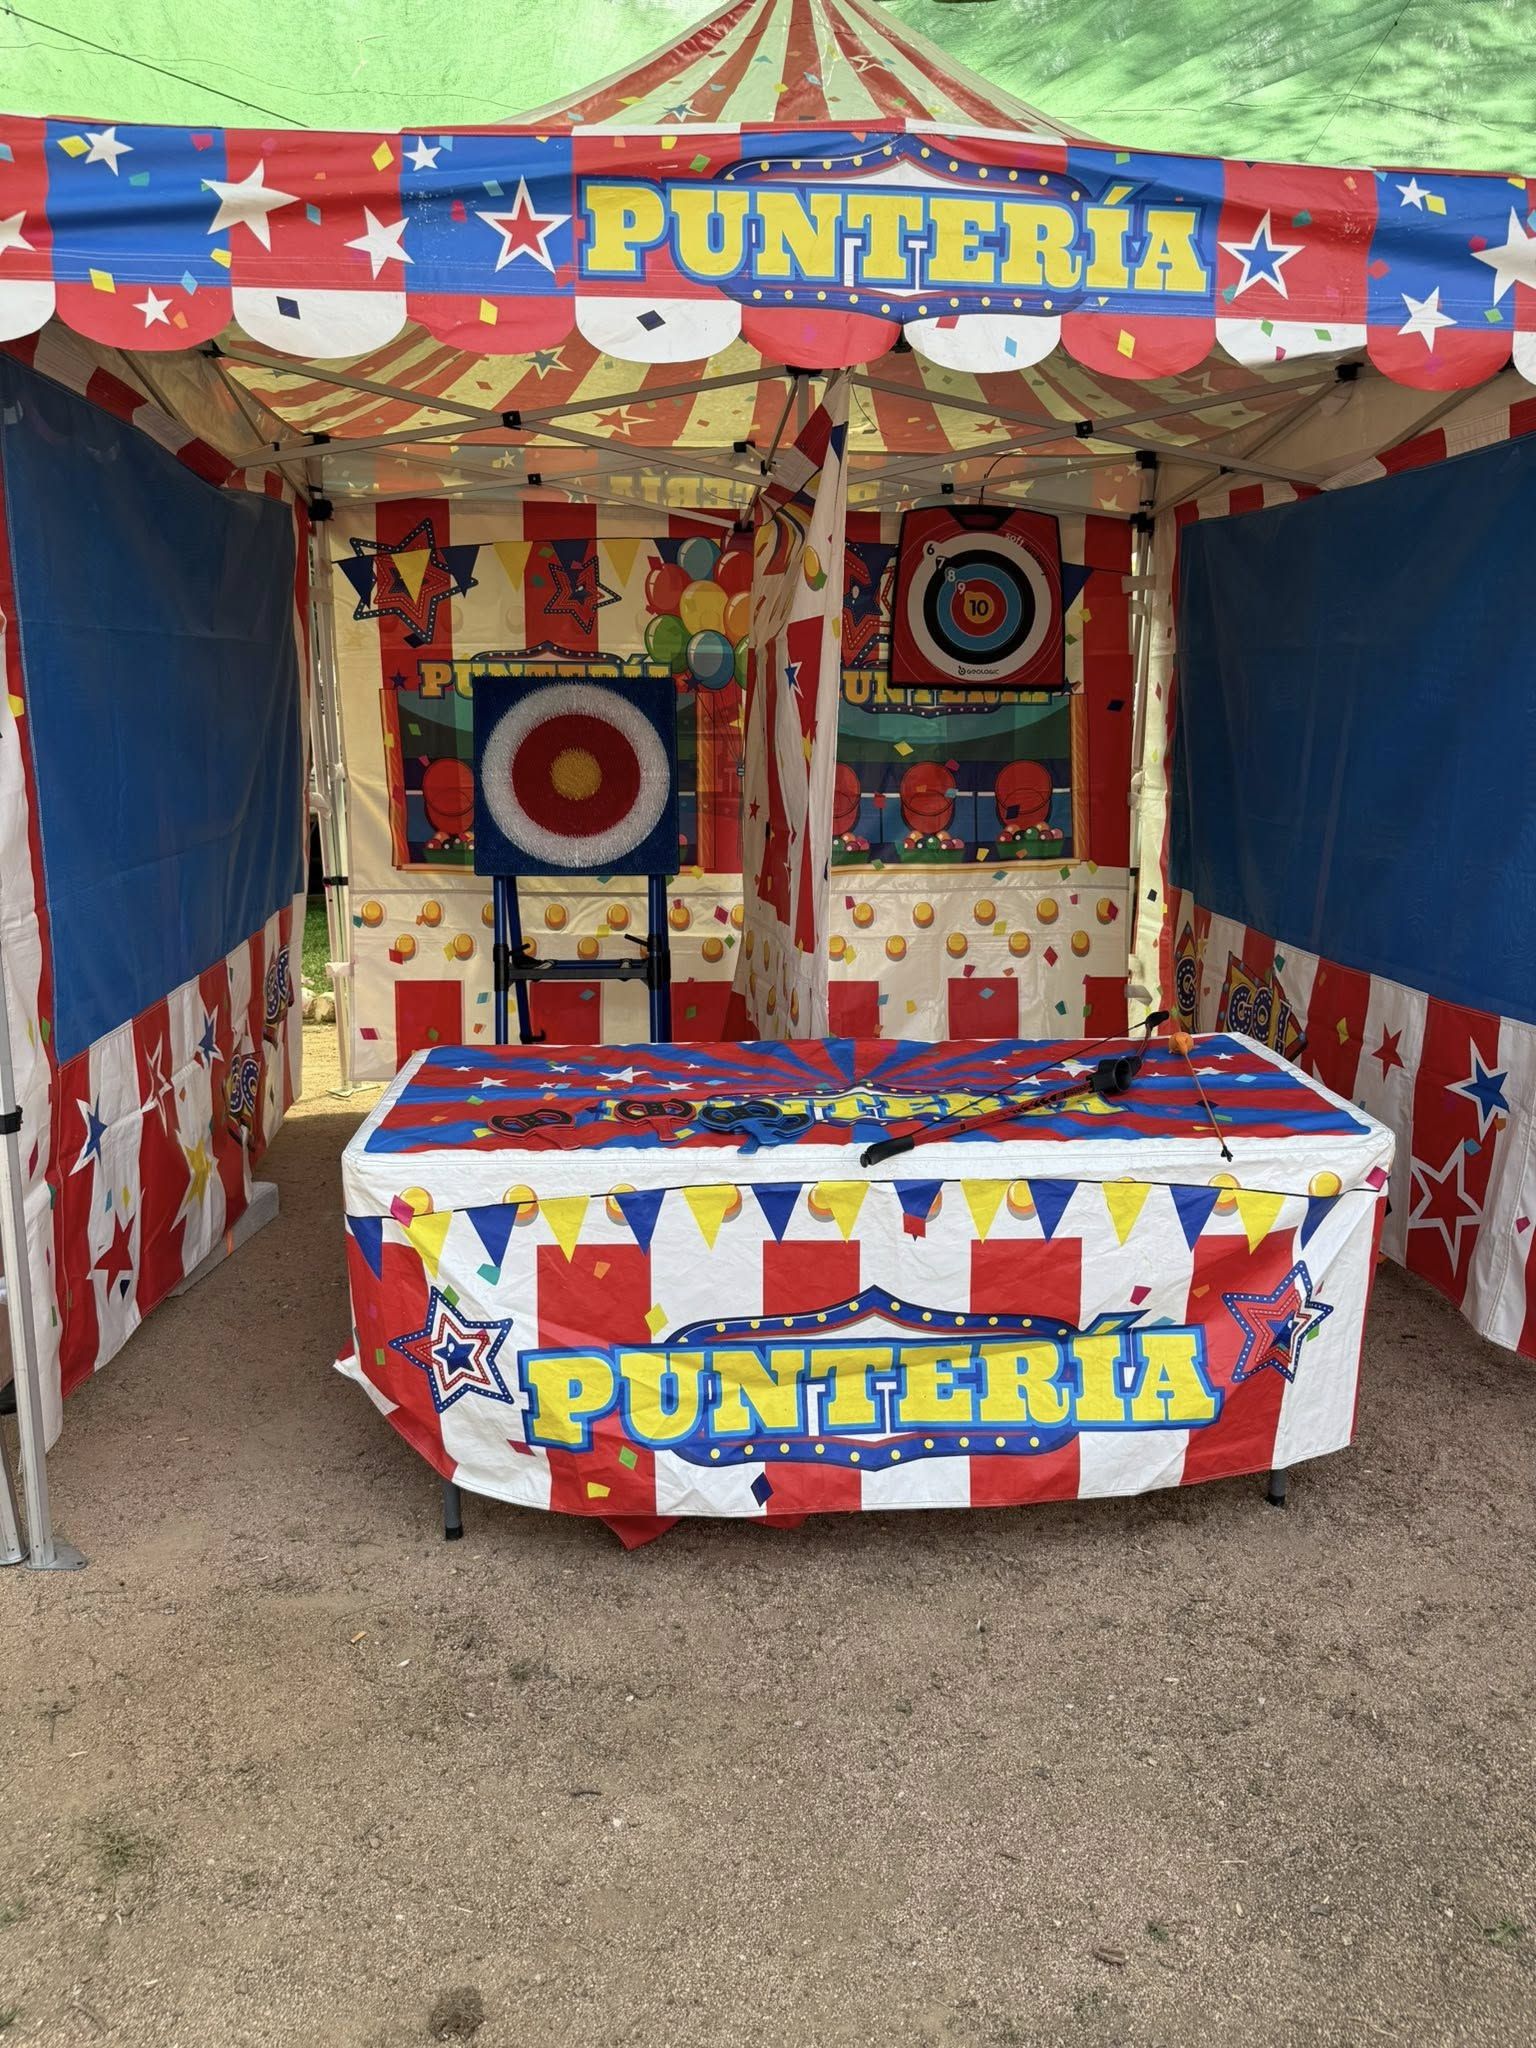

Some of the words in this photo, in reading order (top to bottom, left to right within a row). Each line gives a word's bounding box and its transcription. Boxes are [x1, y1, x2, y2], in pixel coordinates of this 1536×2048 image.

[582, 182, 1211, 293] PUNTERÍA
[926, 543, 935, 556] 6
[936, 556, 946, 570] 7
[947, 569, 956, 582] 8
[957, 582, 966, 595] 9
[969, 599, 990, 616] 10
[522, 1318, 1220, 1447] PUNTERÍA
